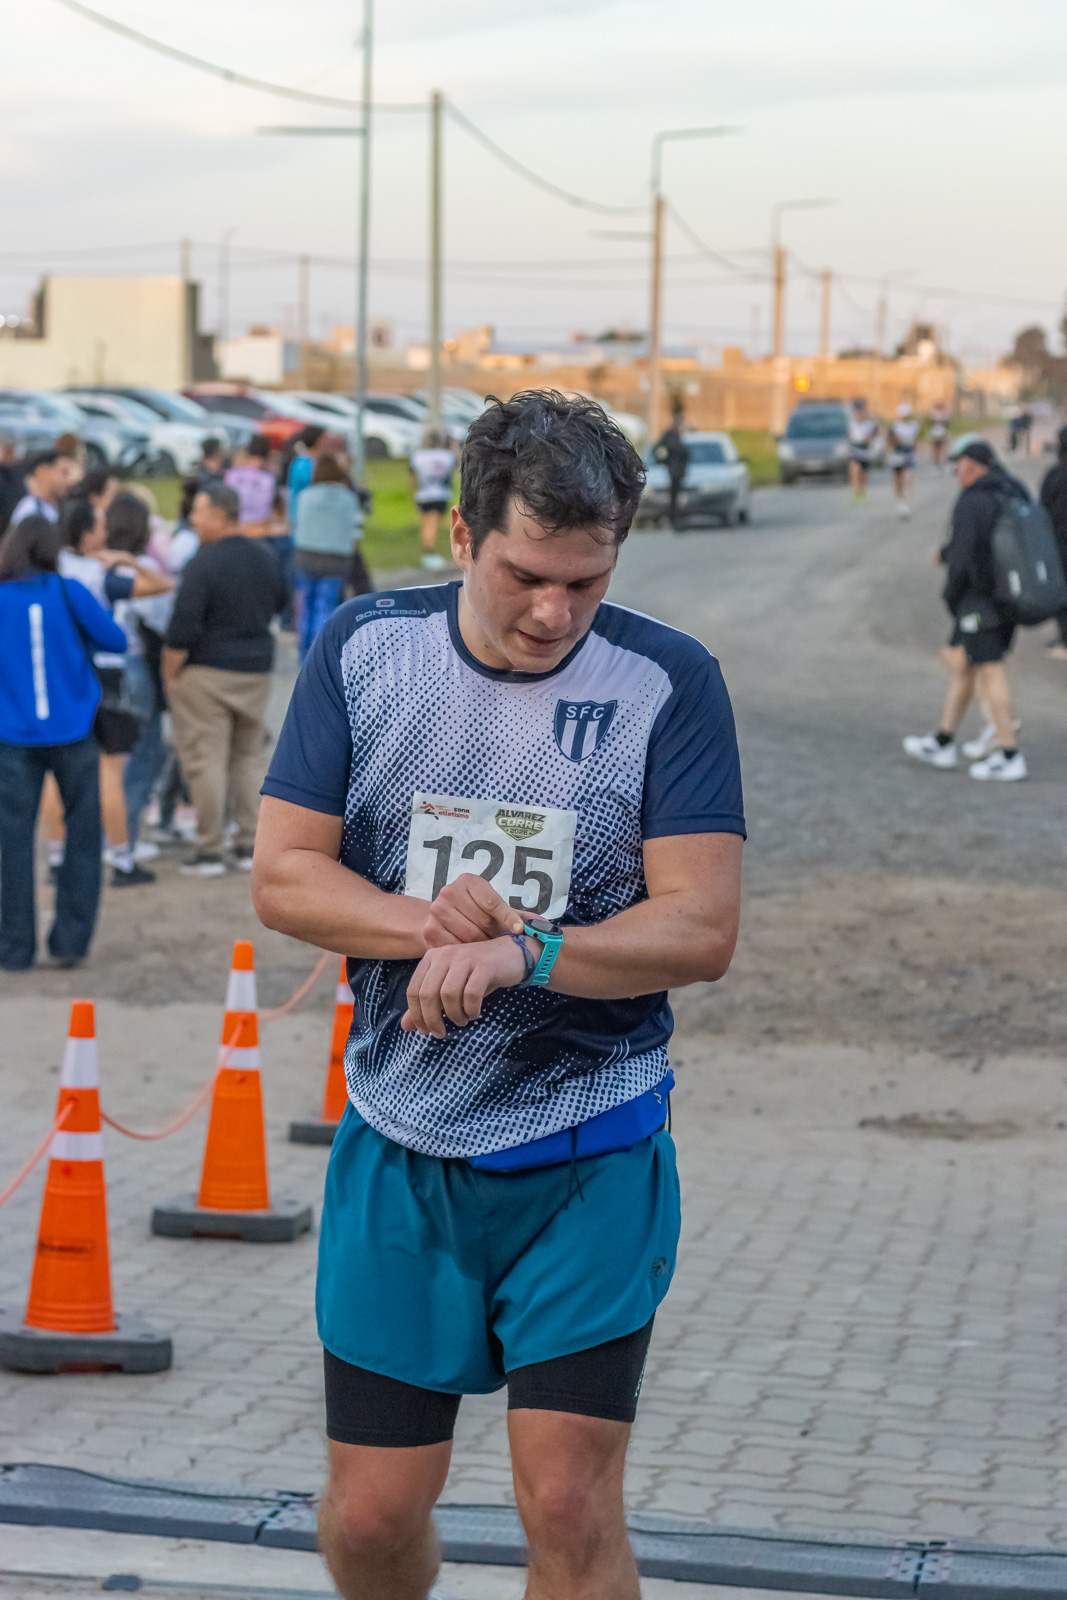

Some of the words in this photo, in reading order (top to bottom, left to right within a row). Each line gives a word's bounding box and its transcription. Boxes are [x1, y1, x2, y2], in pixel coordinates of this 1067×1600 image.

[565, 705, 605, 720] SFC
[438, 811, 470, 819] atletismo
[496, 808, 547, 823] ALVAREZ
[497, 817, 545, 831] CORRE
[422, 835, 554, 915] 125
